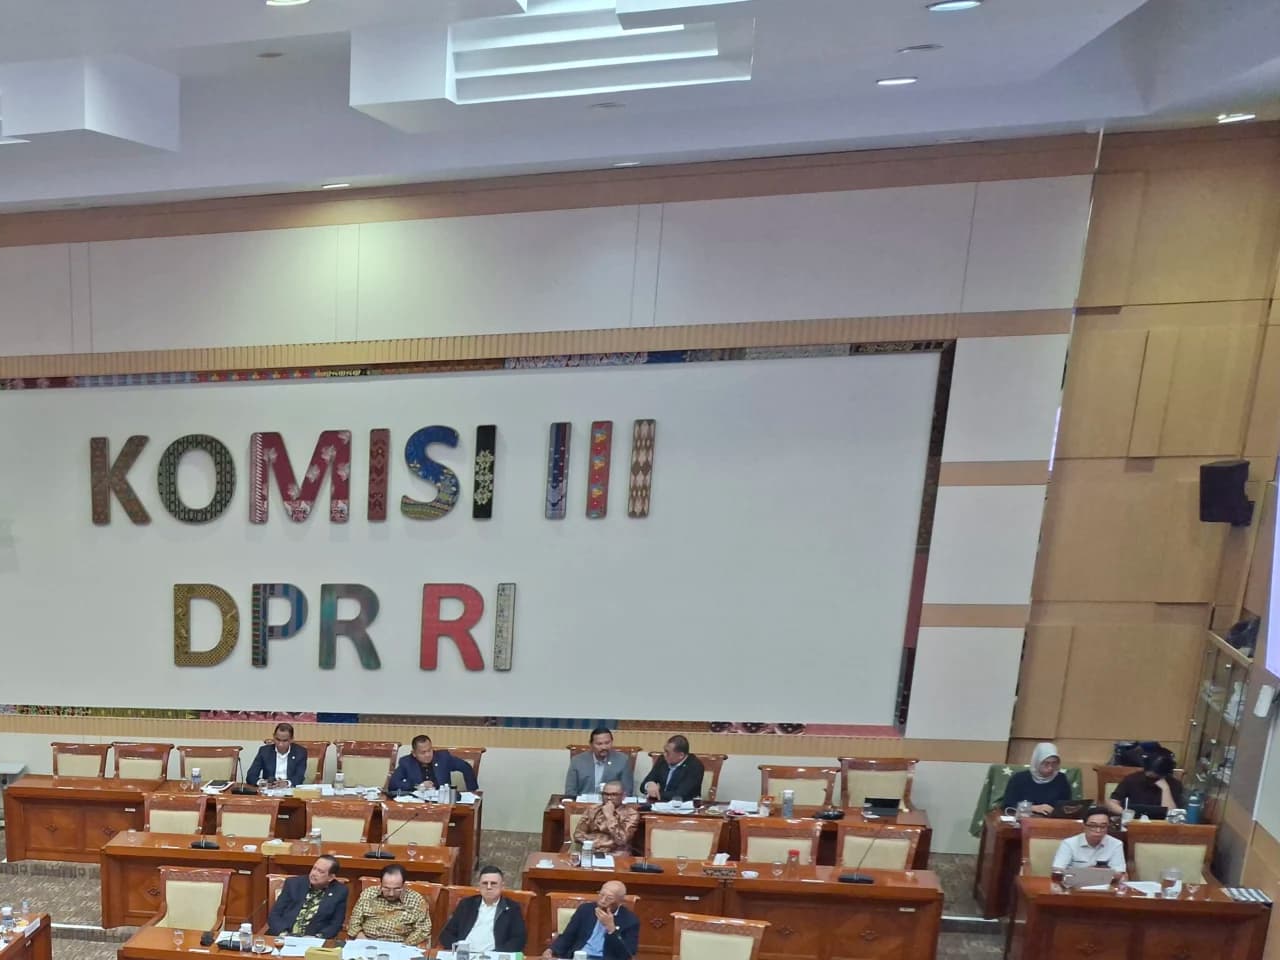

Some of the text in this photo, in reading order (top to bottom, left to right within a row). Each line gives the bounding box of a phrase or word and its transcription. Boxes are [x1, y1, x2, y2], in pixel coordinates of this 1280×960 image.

[90, 419, 656, 525] KOMISI III
[174, 582, 516, 671] DPR RI
